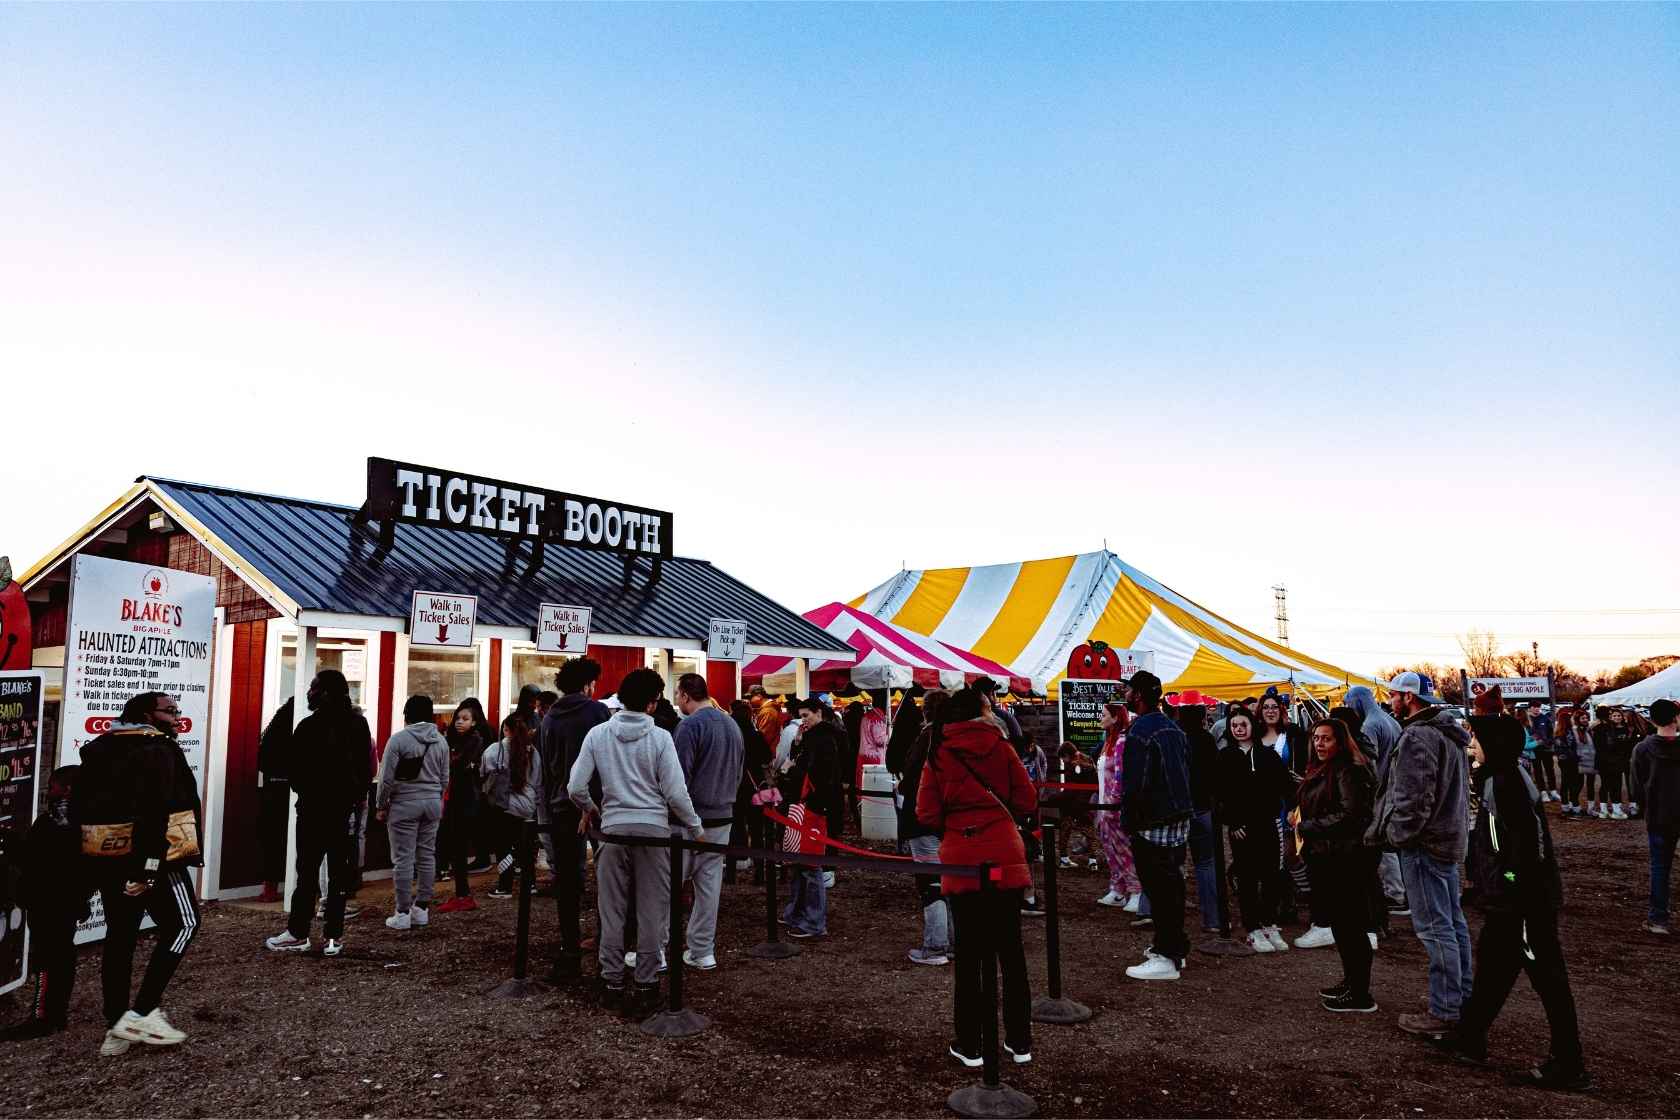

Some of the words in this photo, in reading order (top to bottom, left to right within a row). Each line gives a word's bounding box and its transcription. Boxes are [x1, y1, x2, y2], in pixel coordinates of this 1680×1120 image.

[396, 469, 545, 536] TICKET
[564, 500, 661, 554] BOOTH
[430, 598, 450, 612] Walk
[453, 602, 462, 612] in
[121, 598, 183, 627] BLAKE'S
[419, 610, 446, 624] Ticket
[449, 613, 470, 626] Sales
[553, 609, 570, 622] Walk
[572, 612, 579, 621] in
[133, 625, 147, 633] BIG
[544, 620, 566, 633] Ticket
[567, 622, 585, 634] Sales
[78, 630, 136, 655] HAUNTED
[138, 635, 207, 660] ATTRACTIONS
[85, 653, 108, 665] Friday
[109, 656, 115, 664] &
[117, 655, 147, 667] Saturday
[148, 658, 180, 668] 7pm-11pm
[85, 666, 111, 677] Sunday
[1, 680, 32, 696] BLAKE'S
[83, 678, 106, 689] Ticket
[107, 680, 125, 690] sales
[127, 681, 140, 690] end
[142, 681, 145, 690] 1
[147, 681, 162, 690] hour
[163, 682, 178, 691] prior
[179, 683, 185, 691] to
[83, 690, 102, 700] Walk
[103, 691, 110, 700] in
[87, 702, 100, 711] due
[102, 702, 109, 711] to
[1069, 702, 1096, 711] TICKET
[1067, 710, 1095, 720] Welcome
